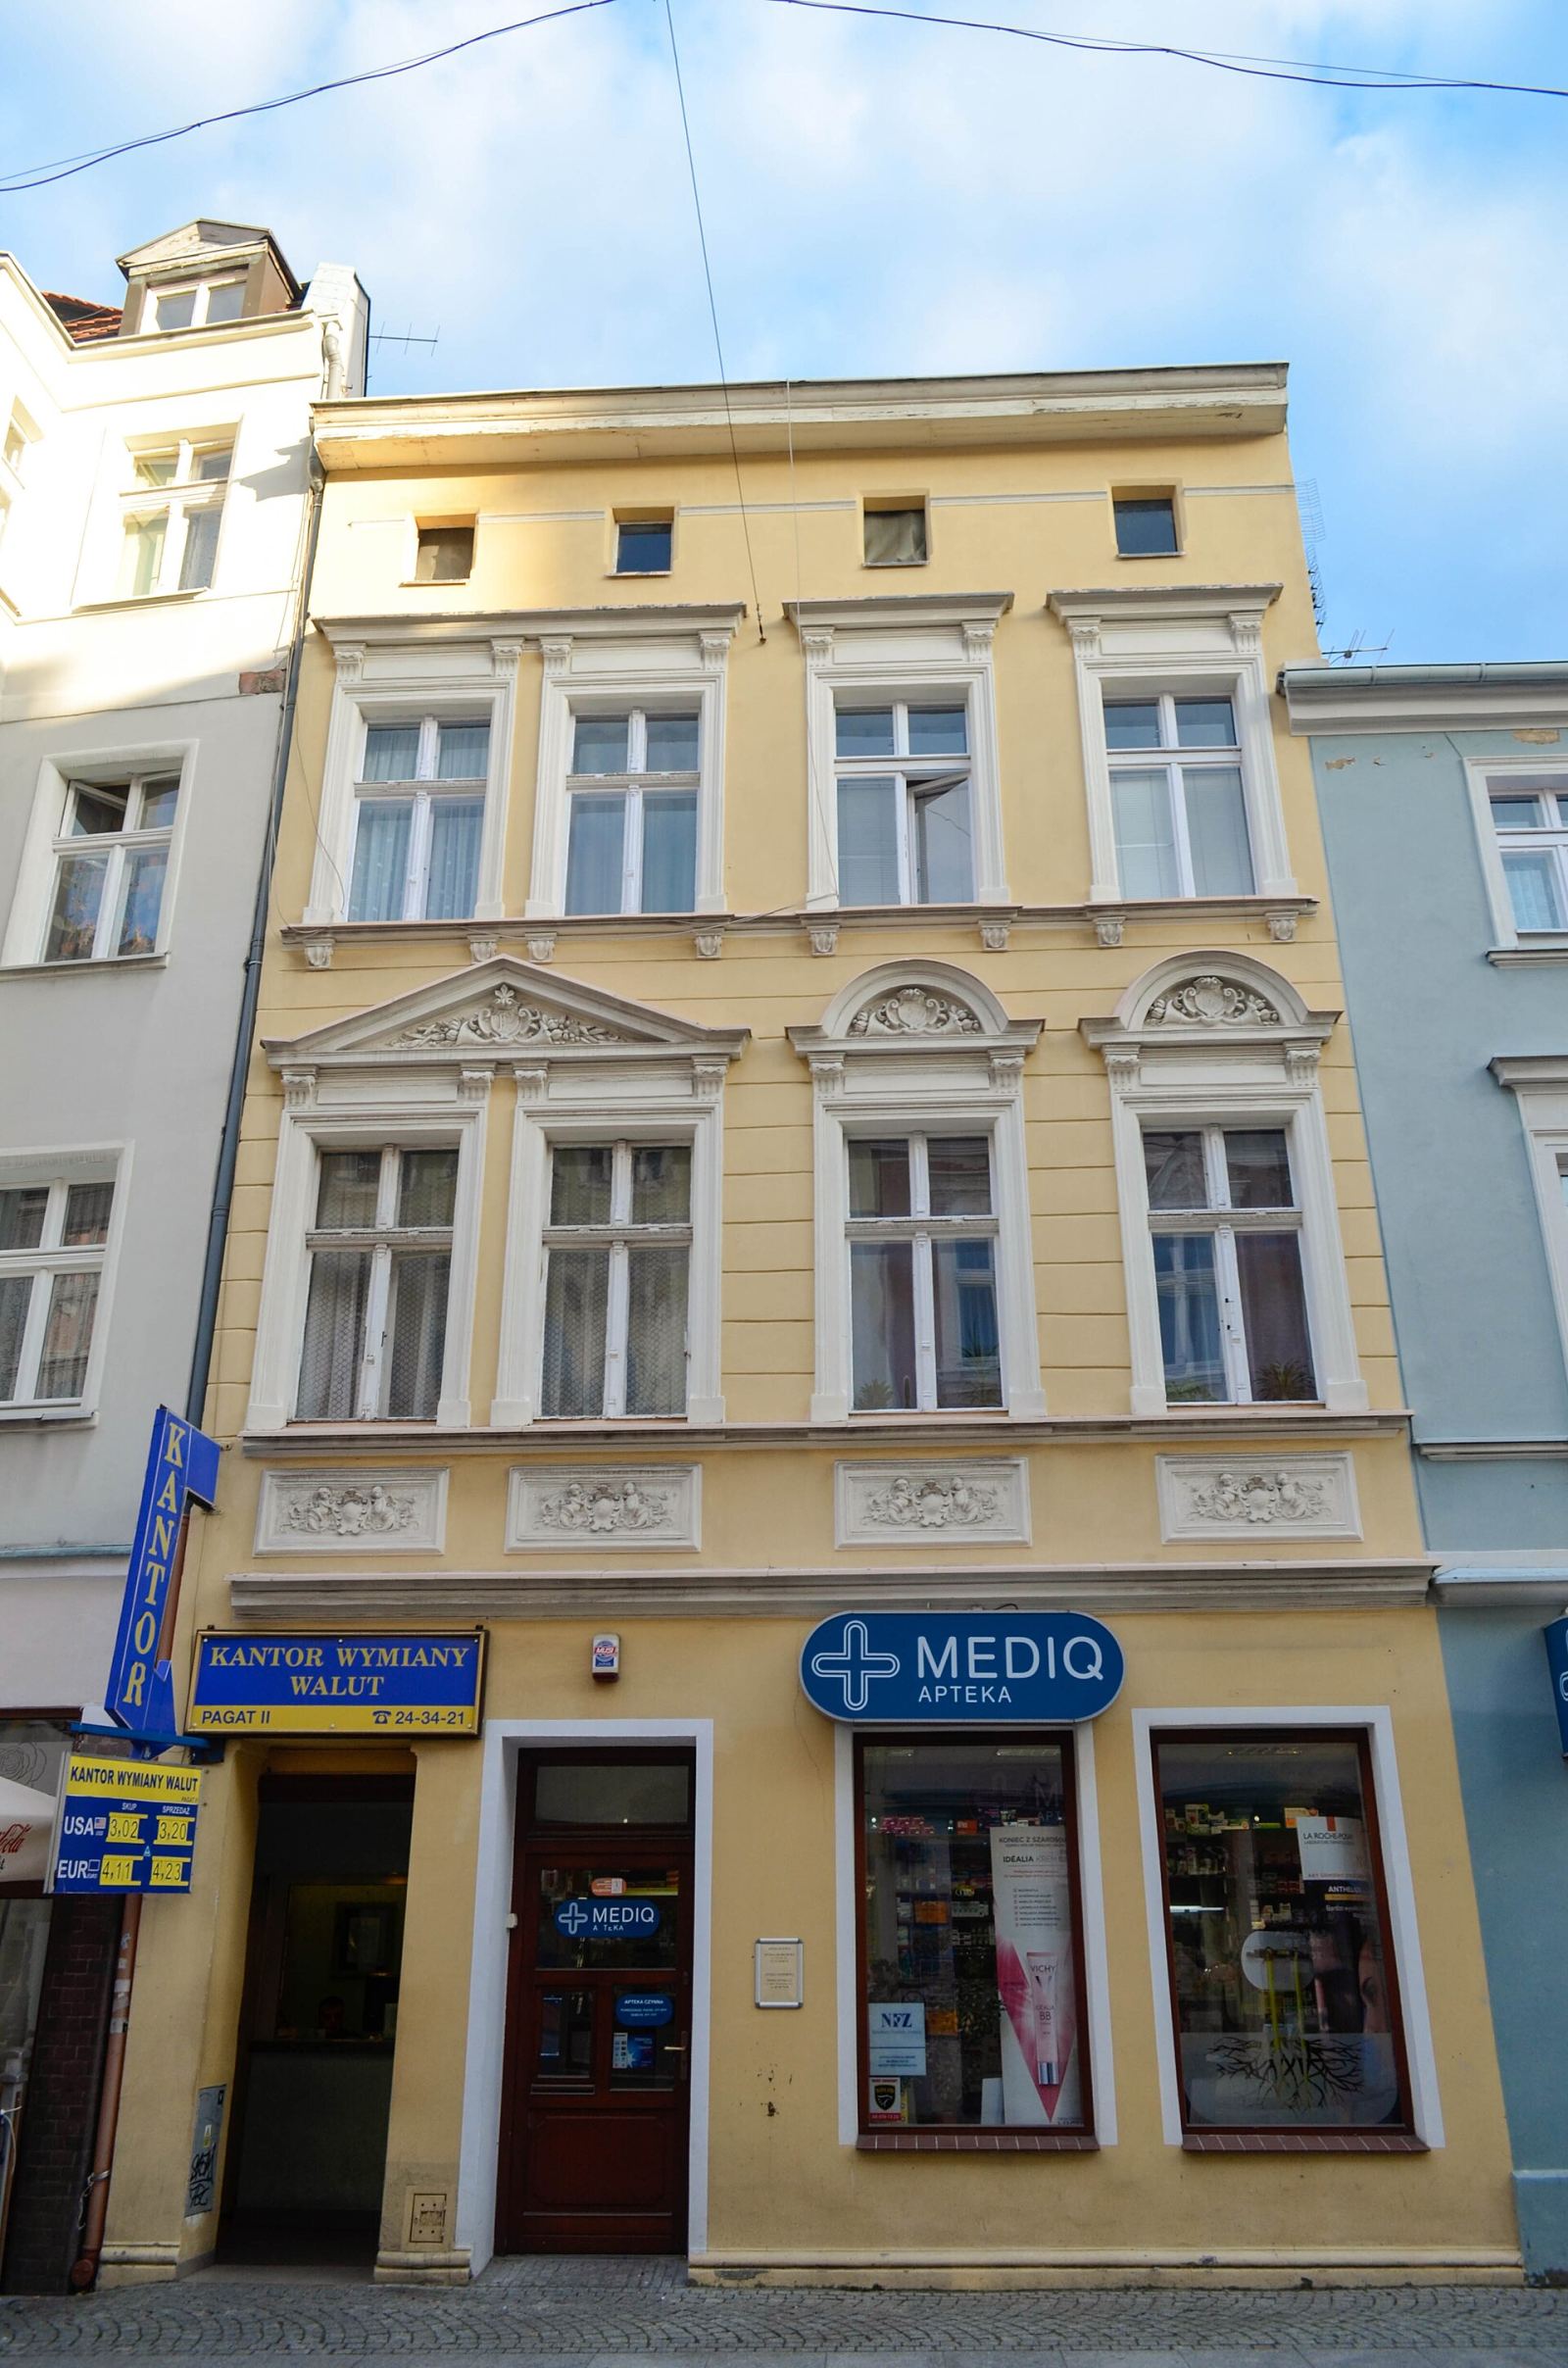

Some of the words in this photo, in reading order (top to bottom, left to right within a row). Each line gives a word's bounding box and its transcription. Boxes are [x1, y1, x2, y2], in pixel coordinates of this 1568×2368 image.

[122, 1421, 186, 1707] KANTOR
[209, 1647, 324, 1667] KANTOR
[336, 1647, 470, 1667] WYMIANY
[916, 1636, 1103, 1681] MEDIQ
[290, 1676, 385, 1696] WALUT
[918, 1686, 1012, 1703] APTEKA
[201, 1710, 257, 1724] PAGAT
[260, 1710, 271, 1724] II
[394, 1710, 465, 1725] 24-34-21
[71, 1766, 115, 1785] KANTOR
[117, 1771, 165, 1790] WYMIANY
[166, 1775, 199, 1792] WALUT
[64, 1816, 95, 1836] USA
[110, 1818, 139, 1838] 3,02
[159, 1821, 187, 1840] 3,20
[57, 1859, 88, 1879] EUR
[102, 1862, 131, 1880] 4,11
[153, 1862, 181, 1881] 4,23
[592, 1907, 656, 1924] MEDIQ
[1030, 1964, 1056, 1973] VICHY
[881, 2013, 912, 2028] NFZ
